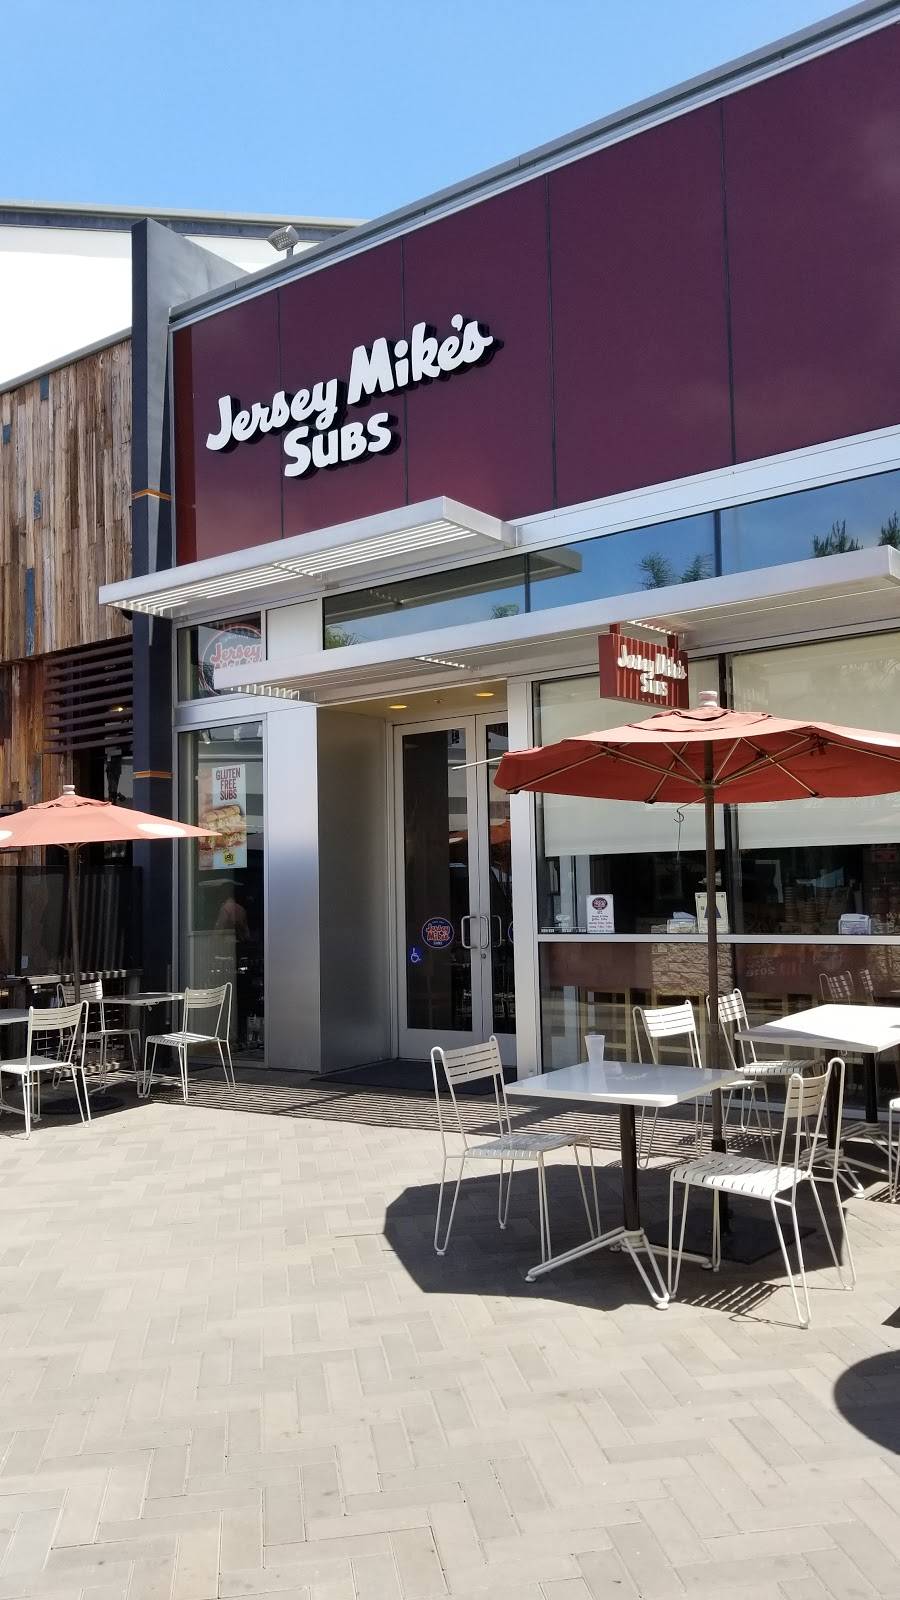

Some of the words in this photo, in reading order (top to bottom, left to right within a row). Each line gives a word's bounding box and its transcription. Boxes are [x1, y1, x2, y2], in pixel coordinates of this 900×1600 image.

[206, 379, 338, 451] Jersey
[347, 314, 493, 404] Mike's
[283, 412, 392, 477] SUBS
[210, 642, 262, 664] Jersey
[215, 767, 241, 781] GLUTEN
[220, 778, 237, 790] FREE
[219, 788, 238, 801] SUBS
